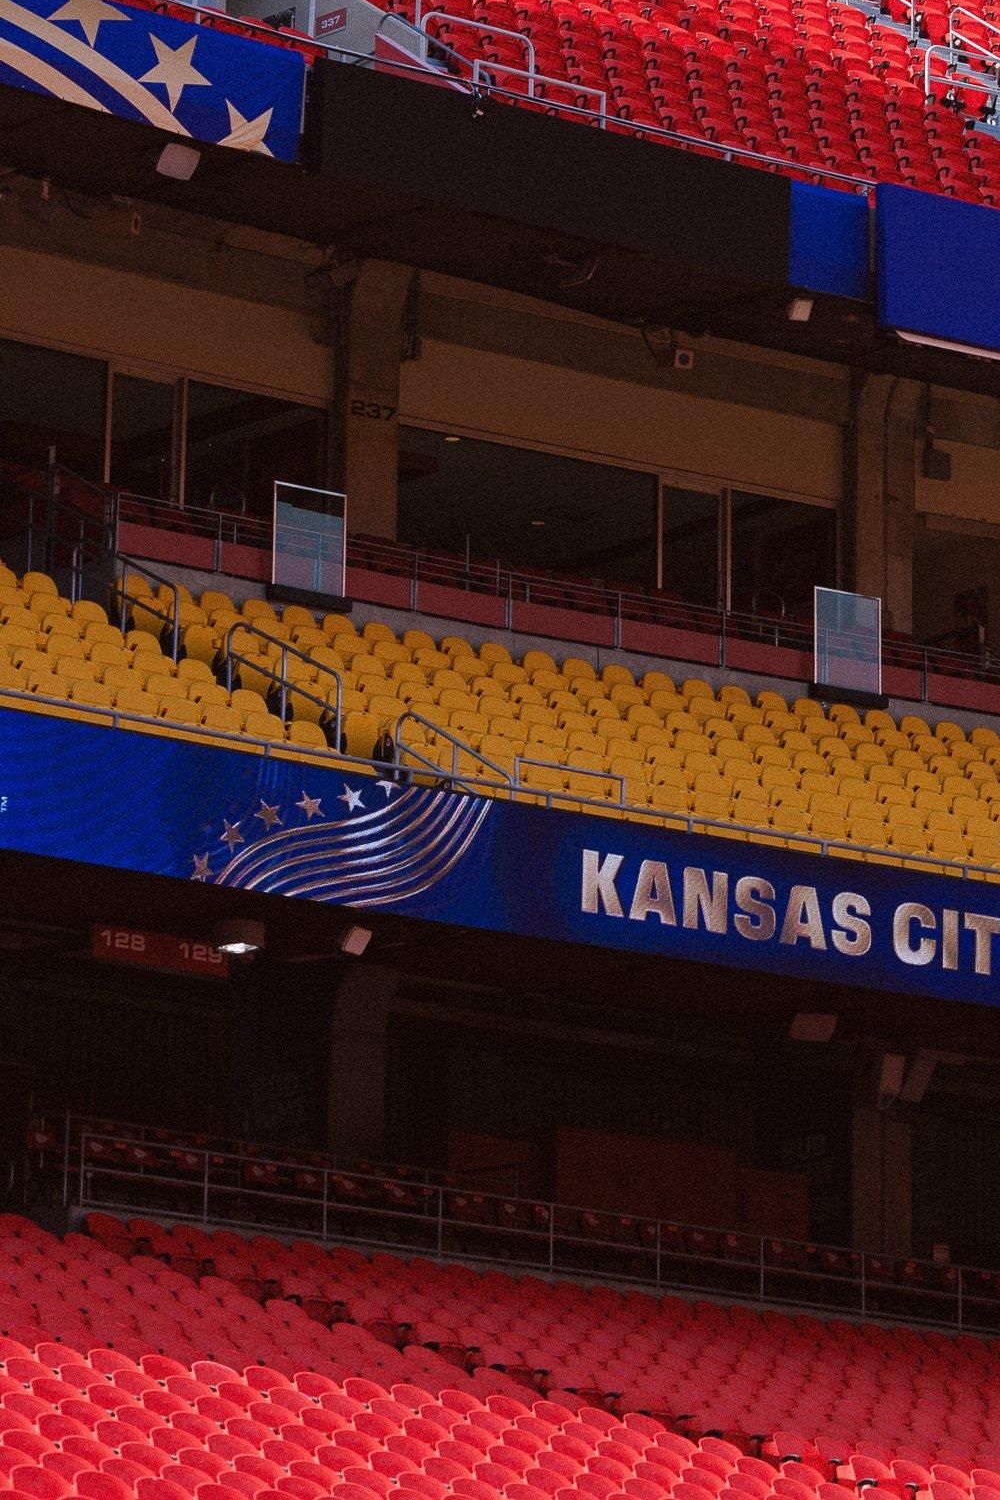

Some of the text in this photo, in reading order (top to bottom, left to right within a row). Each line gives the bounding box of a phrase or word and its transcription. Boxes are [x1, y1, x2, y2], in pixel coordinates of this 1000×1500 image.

[321, 14, 341, 29] 337
[350, 400, 396, 422] 237
[580, 848, 872, 956] KANSAS
[101, 929, 146, 951] 128
